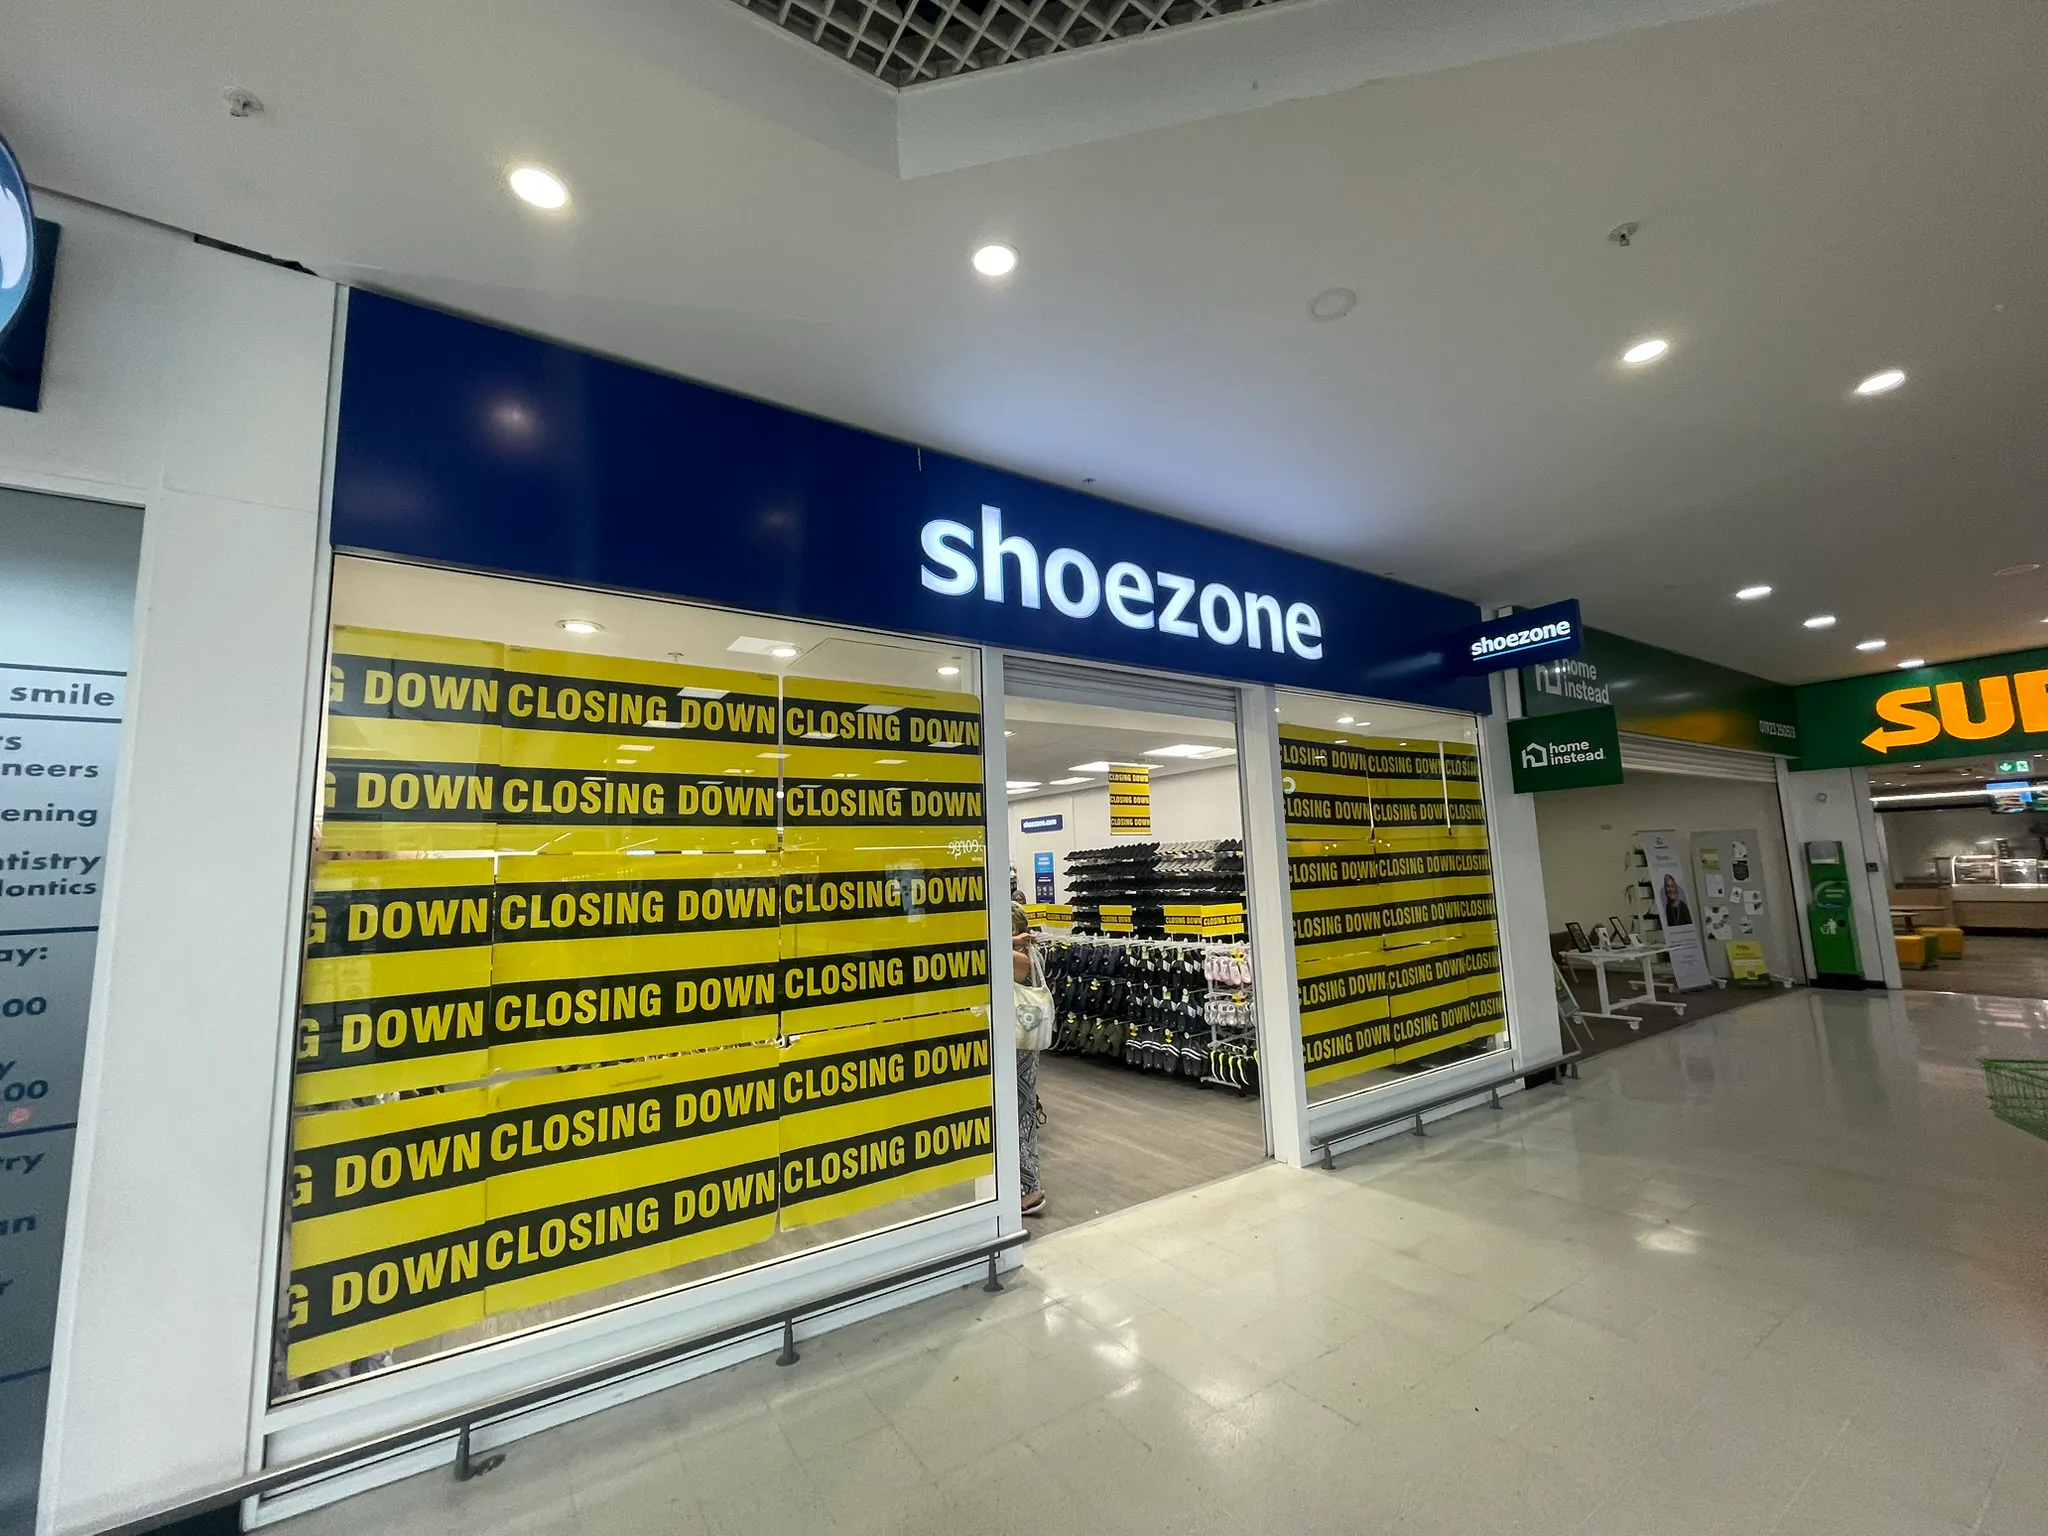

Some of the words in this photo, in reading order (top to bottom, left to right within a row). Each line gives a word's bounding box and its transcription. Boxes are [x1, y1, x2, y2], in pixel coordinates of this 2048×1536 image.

[920, 503, 1323, 660] shoezone
[1471, 620, 1571, 656] shoezone
[1562, 659, 1597, 680] home
[10, 683, 115, 706] smile
[1564, 676, 1610, 704] instead
[364, 670, 498, 713] DOWN
[508, 683, 667, 725] CLOSING
[680, 699, 775, 735] DOWN
[787, 707, 900, 741] CLOSING
[910, 717, 979, 747] DOWN
[1549, 740, 1589, 754] home
[1550, 748, 1605, 766] instead
[1332, 753, 1367, 771] DOWN
[1368, 755, 1412, 774] CLOSING
[1109, 773, 1131, 781] CLOSING
[1133, 774, 1149, 782] DOWN
[357, 773, 493, 810] DOWN
[503, 780, 664, 815] CLOSING
[679, 786, 774, 816] DOWN
[787, 788, 901, 816] CLOSING
[911, 791, 981, 817] DOWN
[1110, 795, 1132, 803] CLOSING
[1111, 818, 1133, 826] CLOSING
[1335, 801, 1370, 820] DOWN
[1372, 804, 1417, 821] CLOSING
[1342, 860, 1377, 880] DOWN
[1378, 857, 1424, 877] CLOSING
[1427, 854, 1455, 873] DOWN
[347, 898, 487, 942] DOWN
[501, 891, 664, 930] CLOSING
[678, 887, 775, 921] DOWN
[784, 880, 900, 914] CLOSING
[911, 875, 983, 906] DOWN
[1165, 916, 1186, 925] CLOSING
[1204, 916, 1225, 926] CLOSING
[1226, 915, 1242, 924] DOWN
[1346, 911, 1381, 933] DOWN
[1383, 906, 1429, 927] CLOSING
[1431, 901, 1460, 921] DOWN
[1349, 971, 1386, 996] DOWN
[1387, 964, 1433, 990] CLOSING
[1436, 957, 1464, 978] DOWN
[341, 1000, 484, 1053] DOWN
[495, 983, 661, 1032] CLOSING
[676, 973, 775, 1013] DOWN
[785, 957, 903, 999] CLOSING
[914, 949, 986, 982] DOWN
[1356, 1024, 1390, 1046] DOWN
[1393, 1015, 1439, 1042] CLOSING
[1442, 1006, 1470, 1029] DOWN
[335, 1131, 479, 1198] DOWN
[490, 1098, 661, 1162] CLOSING
[676, 1078, 775, 1128] DOWN
[784, 1054, 904, 1104] CLOSING
[914, 1040, 988, 1074] DOWN
[331, 1240, 478, 1316] DOWN
[485, 1197, 660, 1271] CLOSING
[674, 1169, 775, 1226] DOWN
[784, 1136, 905, 1195] CLOSING
[915, 1116, 990, 1160] DOWN
